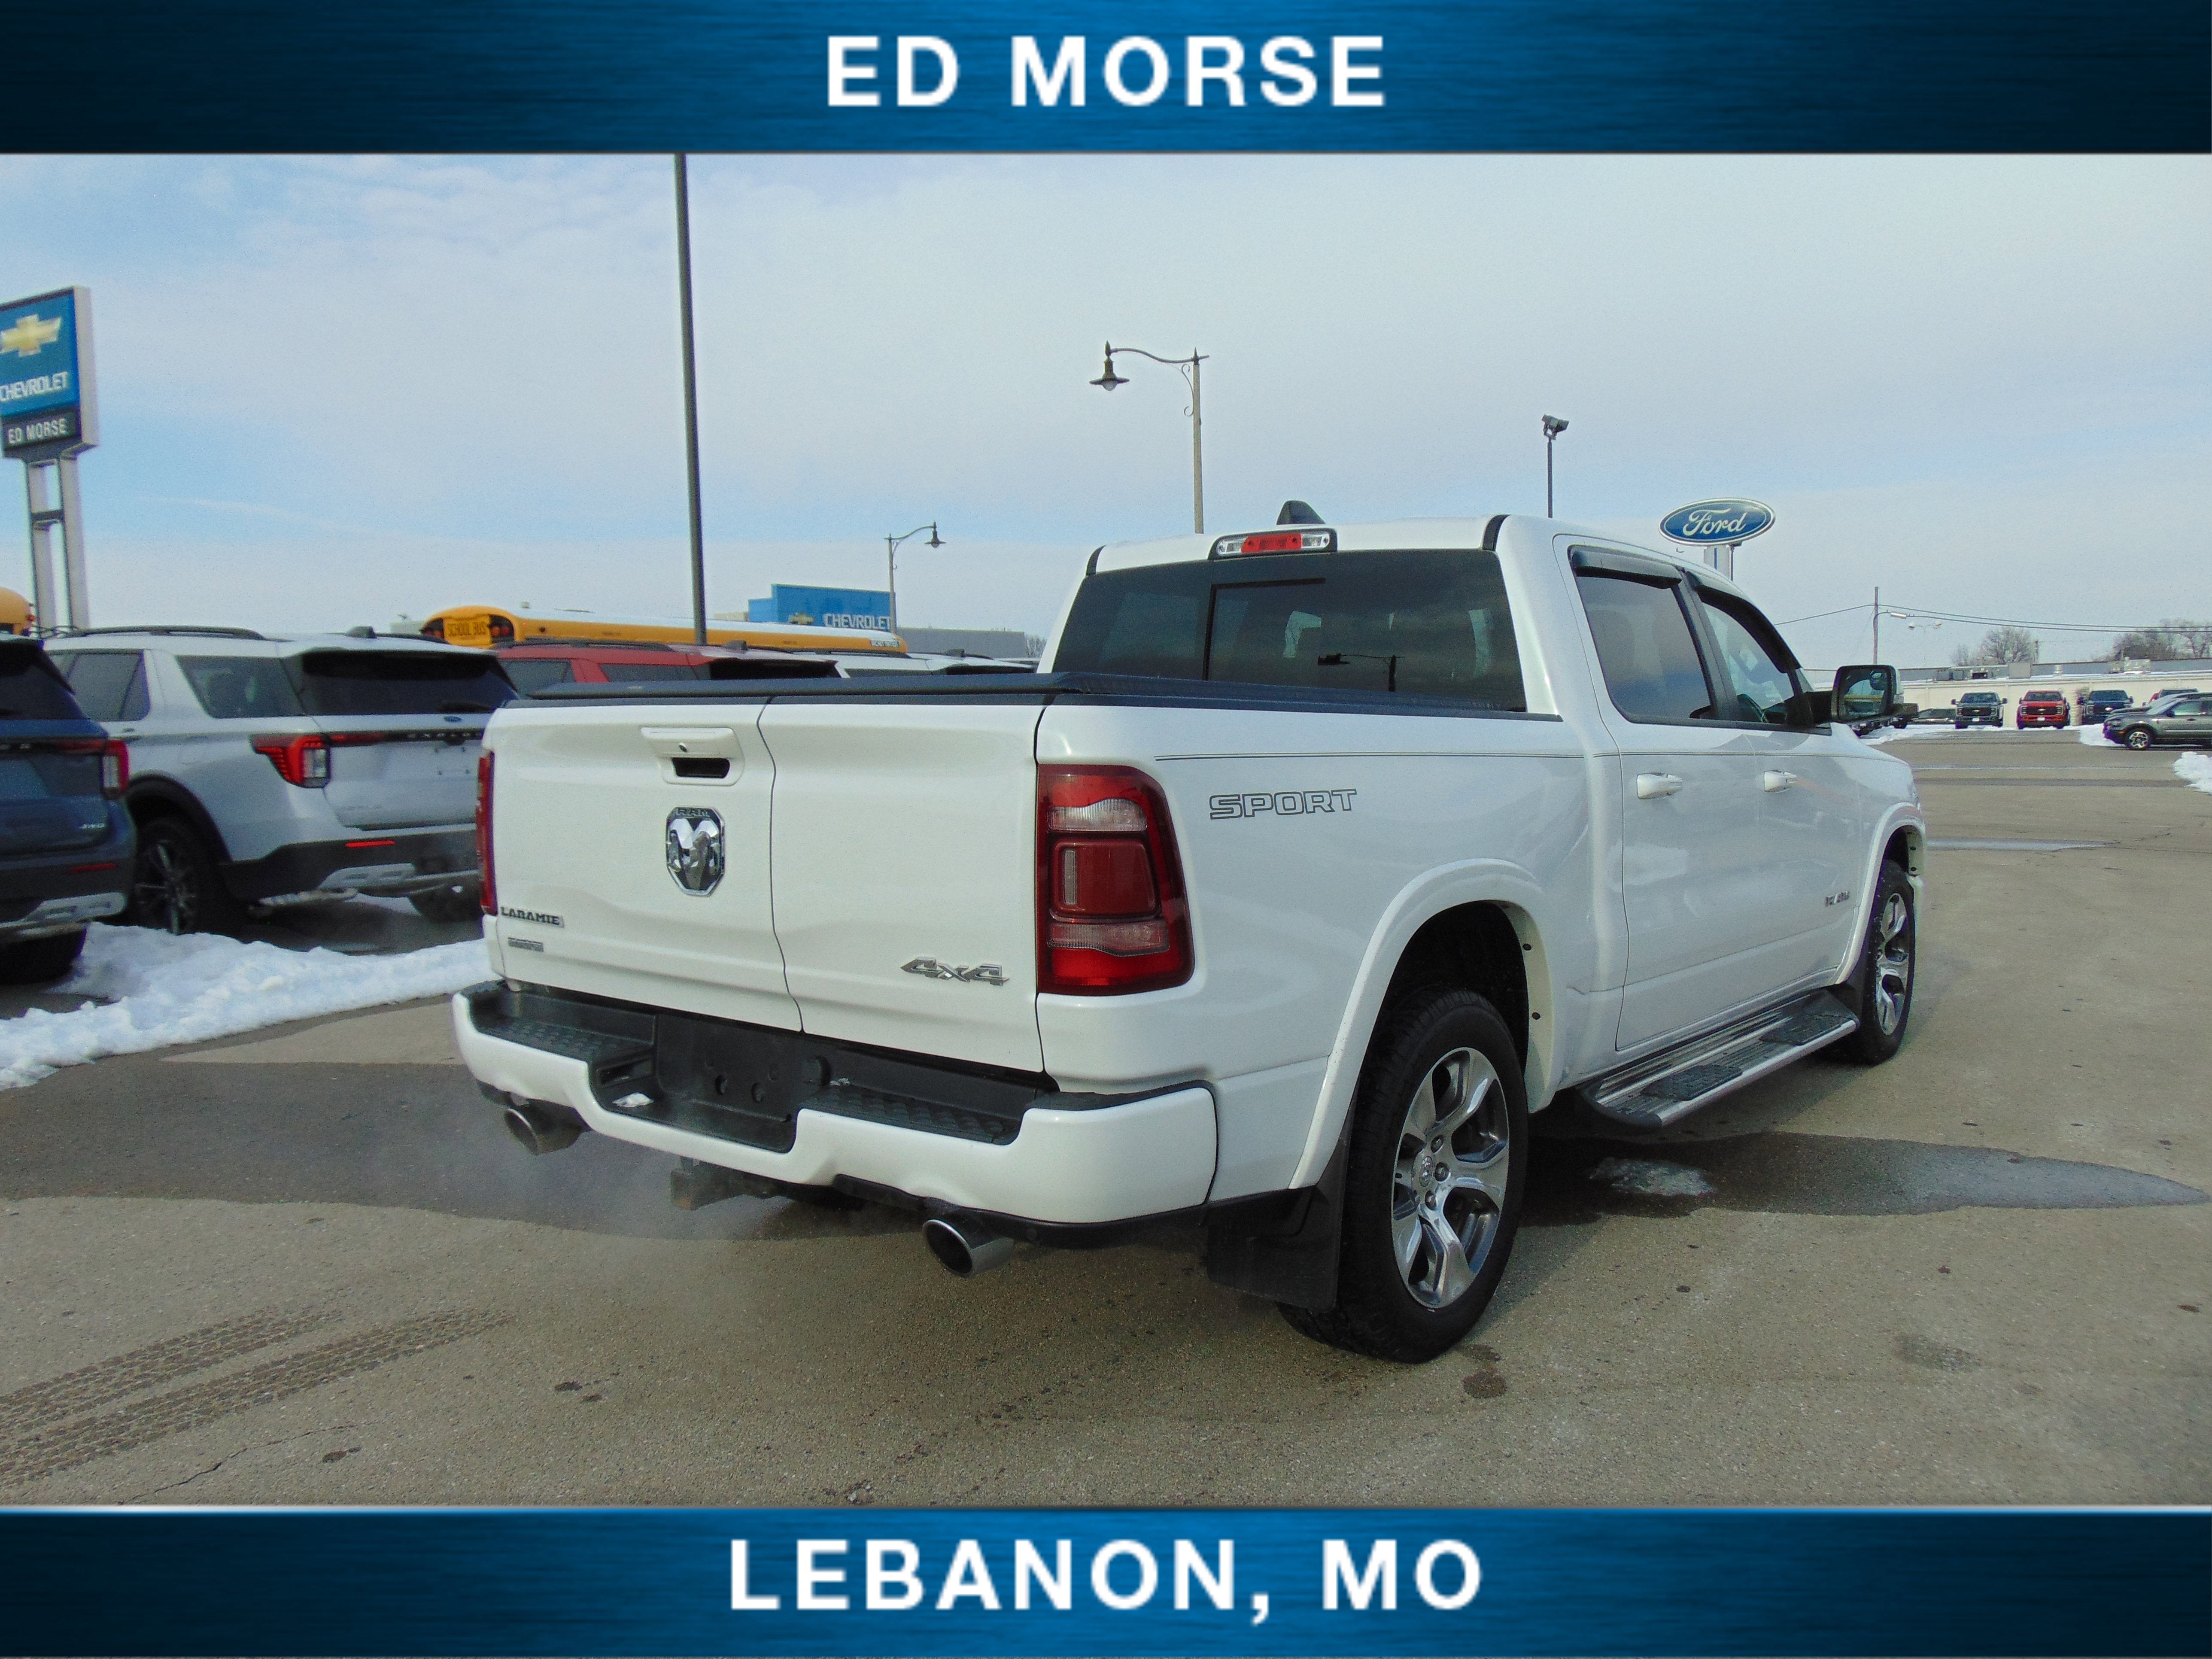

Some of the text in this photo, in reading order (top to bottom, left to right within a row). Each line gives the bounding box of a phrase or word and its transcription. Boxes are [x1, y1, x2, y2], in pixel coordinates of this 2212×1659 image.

[0, 371, 68, 401] CHEVROLET
[9, 418, 67, 444] ED MORSE
[1682, 508, 1747, 536] Ford
[1209, 788, 1358, 820] SPORT
[500, 906, 560, 926] LARAMIE
